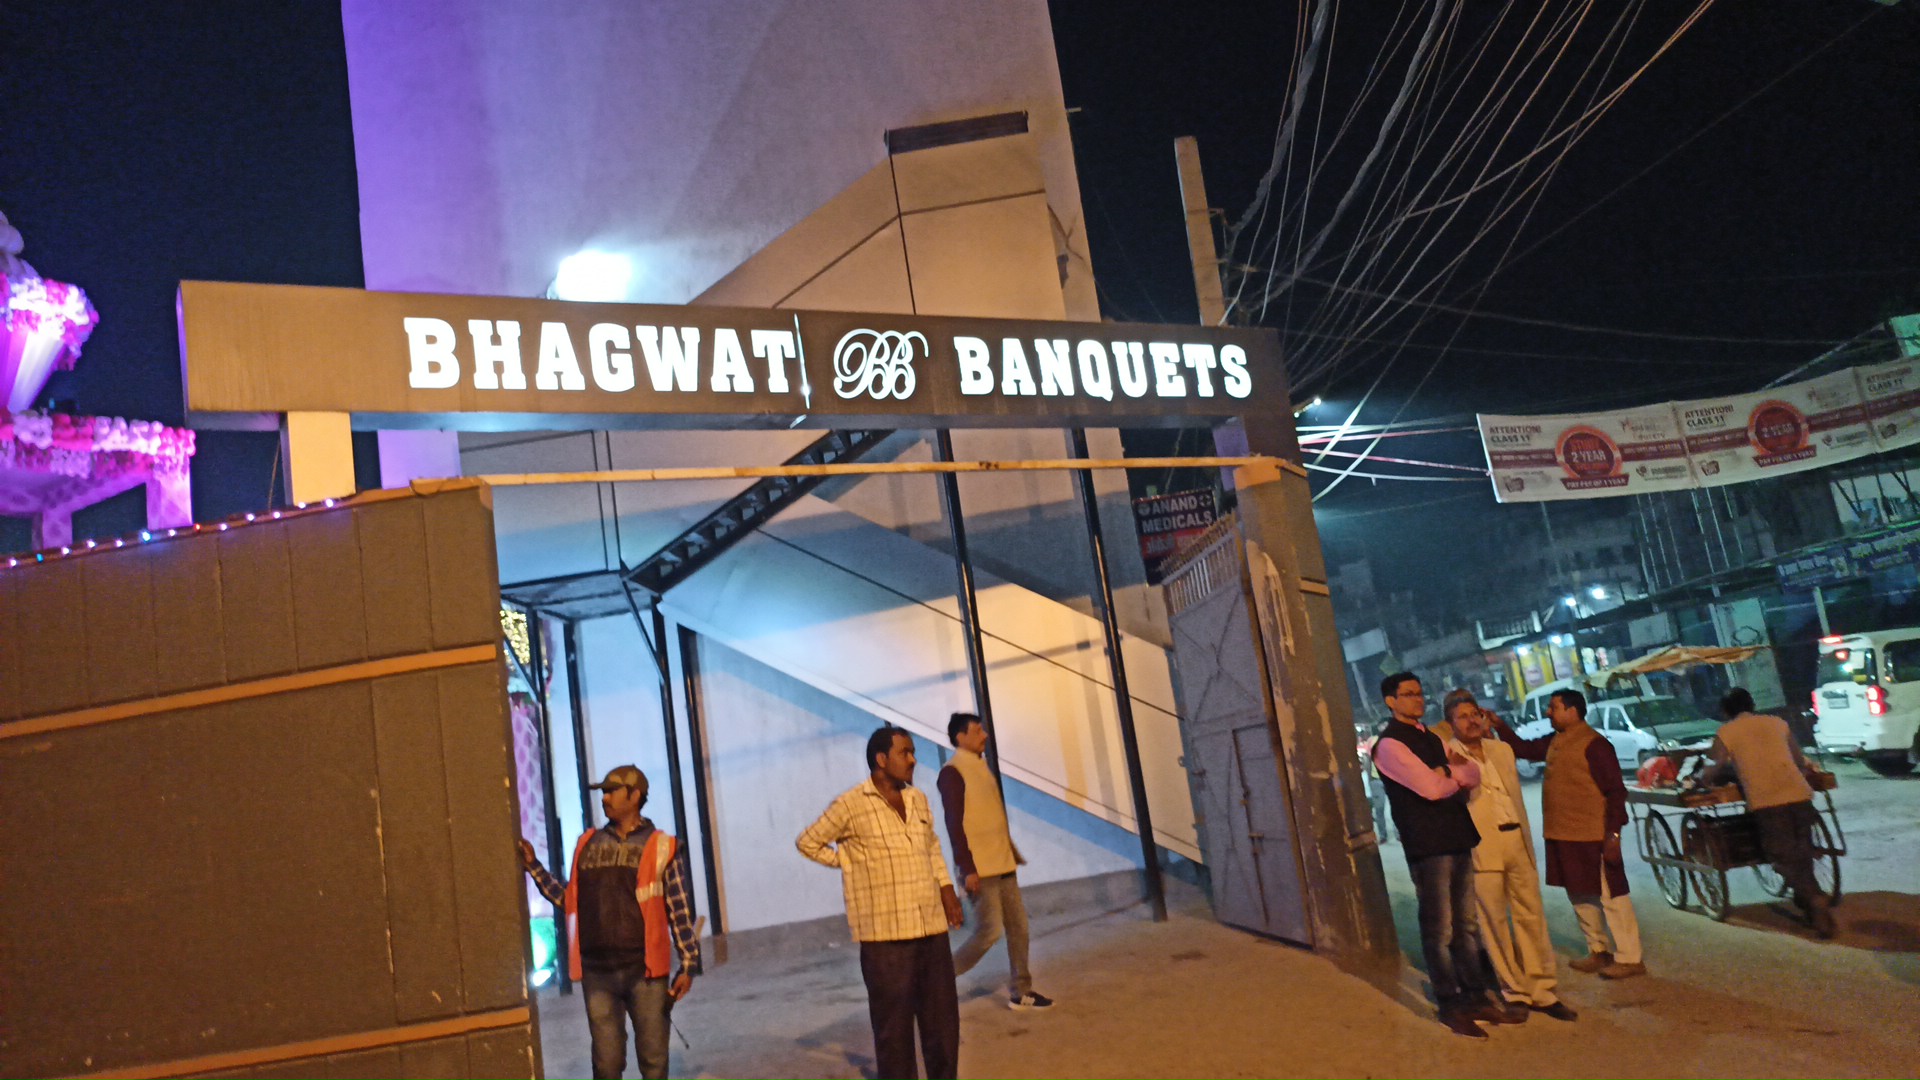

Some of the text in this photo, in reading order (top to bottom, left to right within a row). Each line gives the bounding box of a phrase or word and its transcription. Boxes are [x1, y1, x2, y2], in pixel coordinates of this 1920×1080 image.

[403, 317, 796, 393] BHAGWAT
[953, 336, 1252, 402] BANQUETS
[1687, 416, 1713, 427] CLASS
[1491, 434, 1518, 443] CLASS
[1571, 449, 1606, 463] 2 YEAR
[1152, 495, 1198, 515] ANAND
[1142, 510, 1213, 533] MEDICALS
